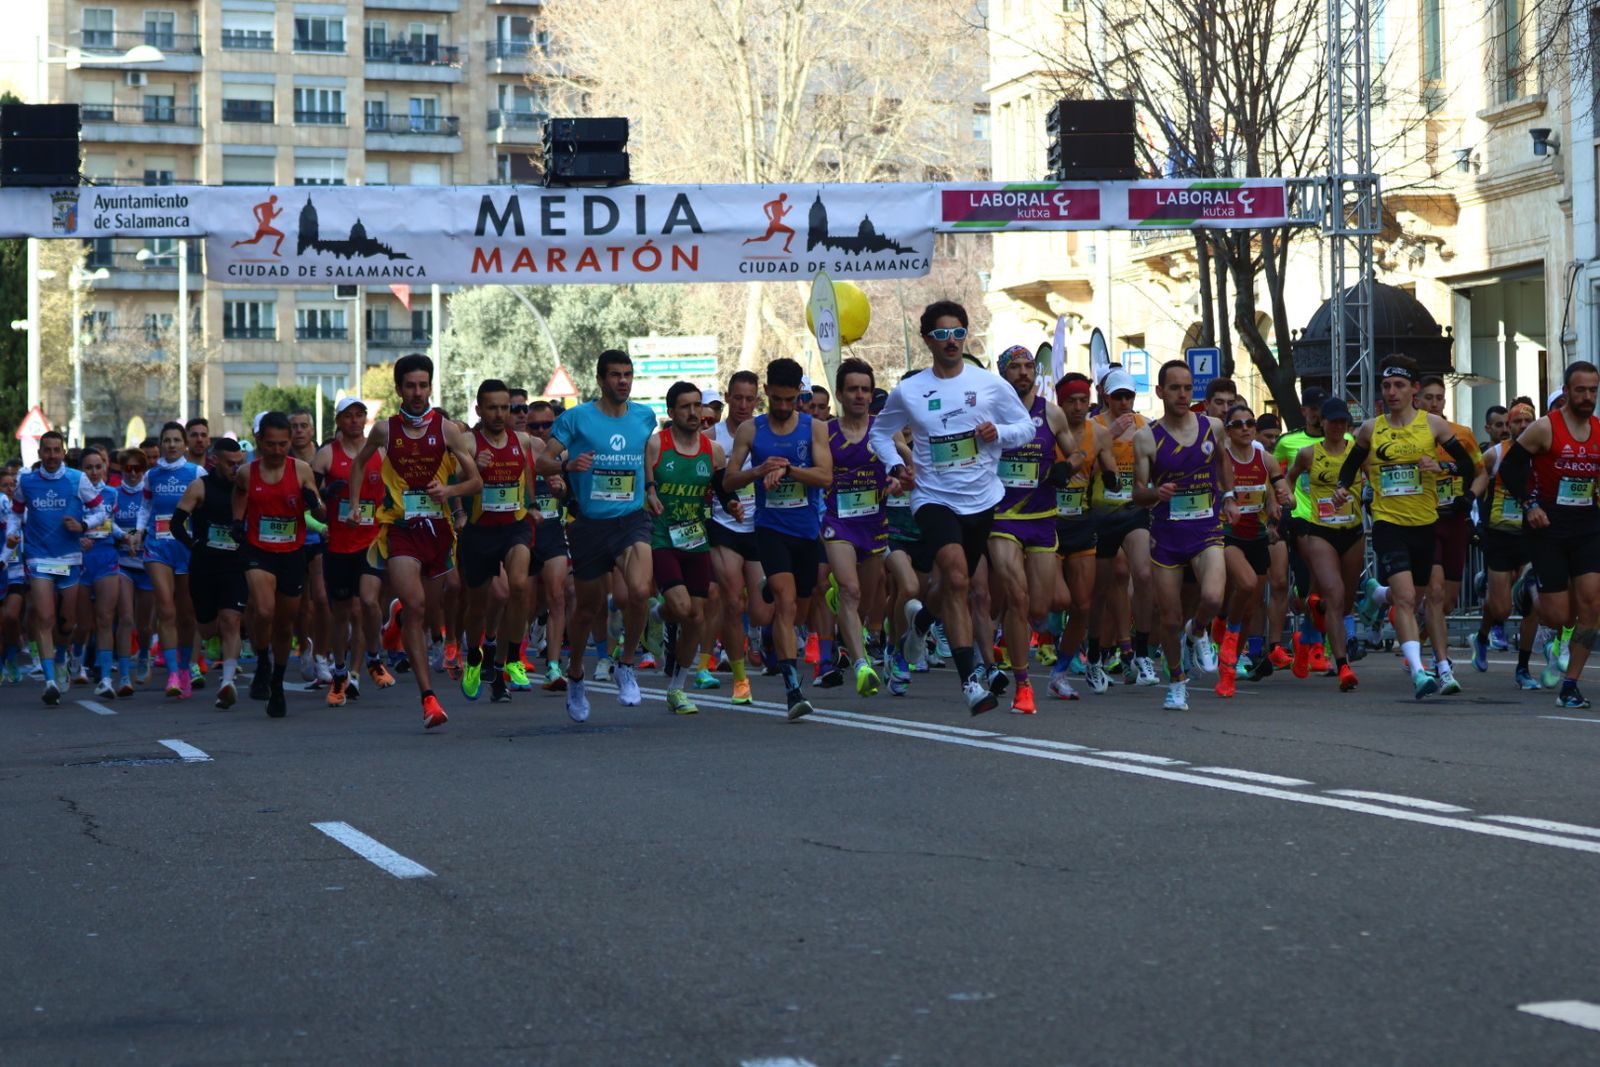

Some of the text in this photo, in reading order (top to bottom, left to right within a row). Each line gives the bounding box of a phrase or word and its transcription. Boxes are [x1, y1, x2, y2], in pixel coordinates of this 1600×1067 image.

[94, 193, 189, 212] Ayuntamiento
[970, 192, 1050, 207] LABORAL
[1156, 191, 1234, 205] LABORAL
[474, 192, 704, 236] MEDIA
[1017, 208, 1050, 219] kutxa
[1203, 206, 1236, 217] kutxa
[94, 213, 190, 229] de Salamanca
[470, 239, 699, 274] MARATÓN
[227, 264, 427, 278] CIUDAD DE SALAMANCA
[739, 258, 930, 274] CIUDAD DE SALAMANCA
[950, 443, 958, 453] 3
[1010, 464, 1023, 472] 11
[1389, 470, 1414, 480] 1008
[608, 477, 621, 486] 13
[155, 482, 187, 493] debra
[499, 489, 506, 497] 9
[1571, 483, 1588, 492] 602
[33, 498, 66, 508] debra
[855, 493, 862, 502] 7
[1190, 497, 1194, 505] 1
[270, 522, 288, 531] 887
